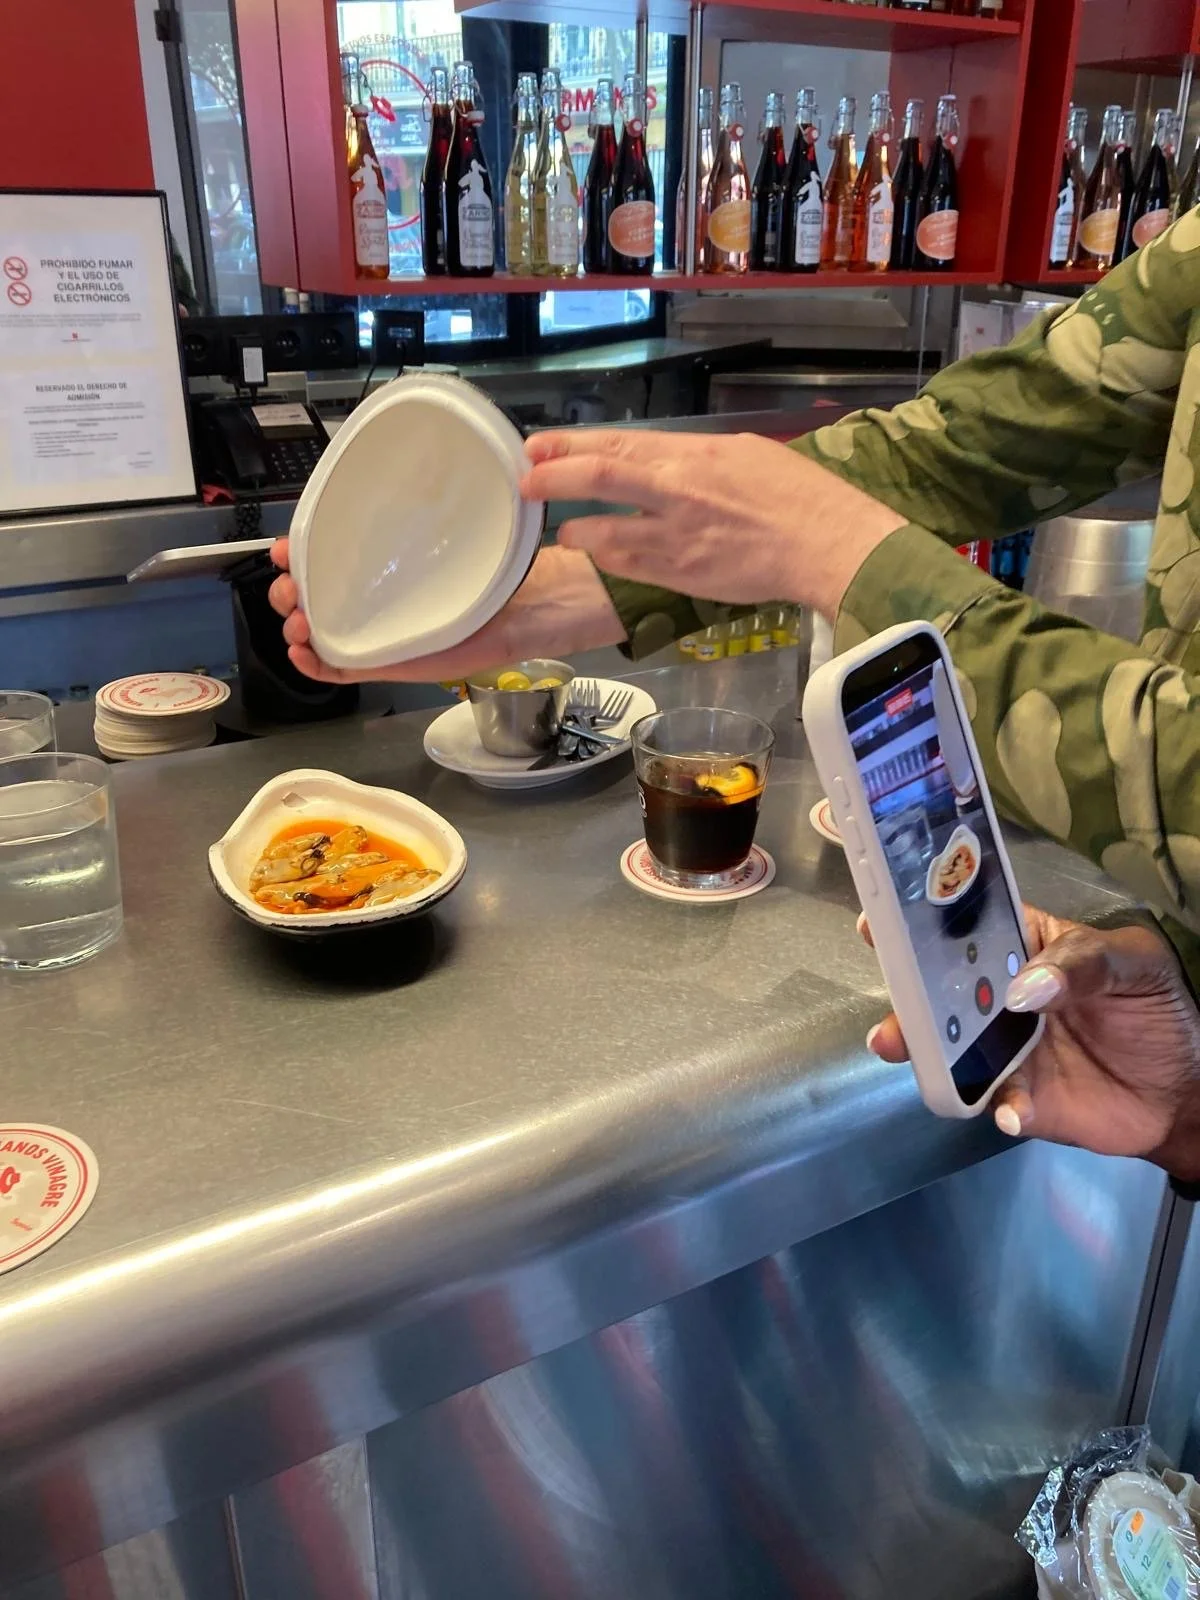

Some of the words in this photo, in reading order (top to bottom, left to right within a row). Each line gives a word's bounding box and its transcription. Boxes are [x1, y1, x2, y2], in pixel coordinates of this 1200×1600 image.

[40, 259, 97, 269] PROHIBIDO
[98, 259, 134, 269] FUMAR
[58, 271, 65, 280] Y
[67, 271, 81, 280] EL
[82, 271, 104, 280] USO
[106, 271, 120, 280] DE
[56, 282, 124, 292] CIGARRILLOS
[0, 1140, 49, 1160] ANOS
[40, 1154, 67, 1208] VINAGRE
